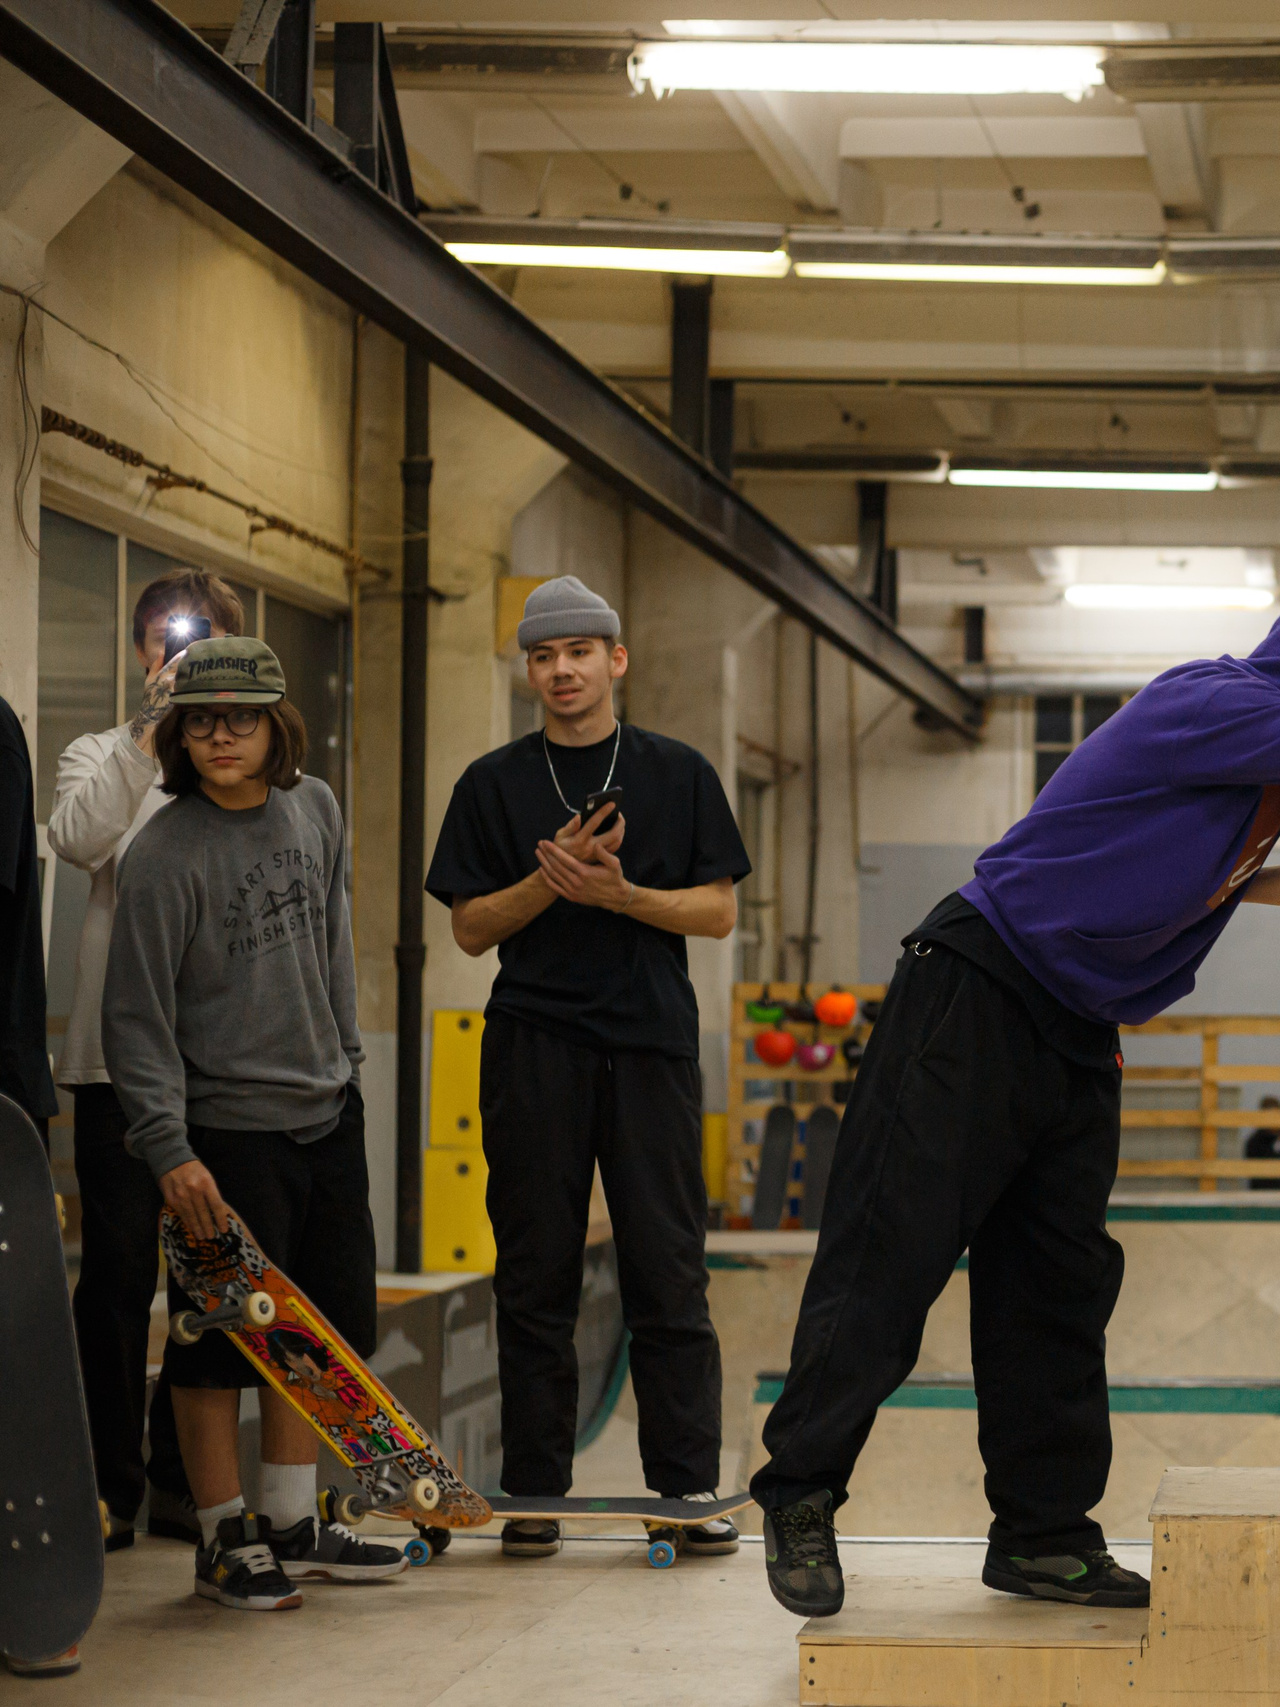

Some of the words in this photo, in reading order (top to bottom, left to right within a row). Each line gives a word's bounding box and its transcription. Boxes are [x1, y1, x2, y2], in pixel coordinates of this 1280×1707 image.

[188, 657, 258, 679] THRASHER
[224, 862, 265, 929] START
[227, 921, 285, 957] FINISH
